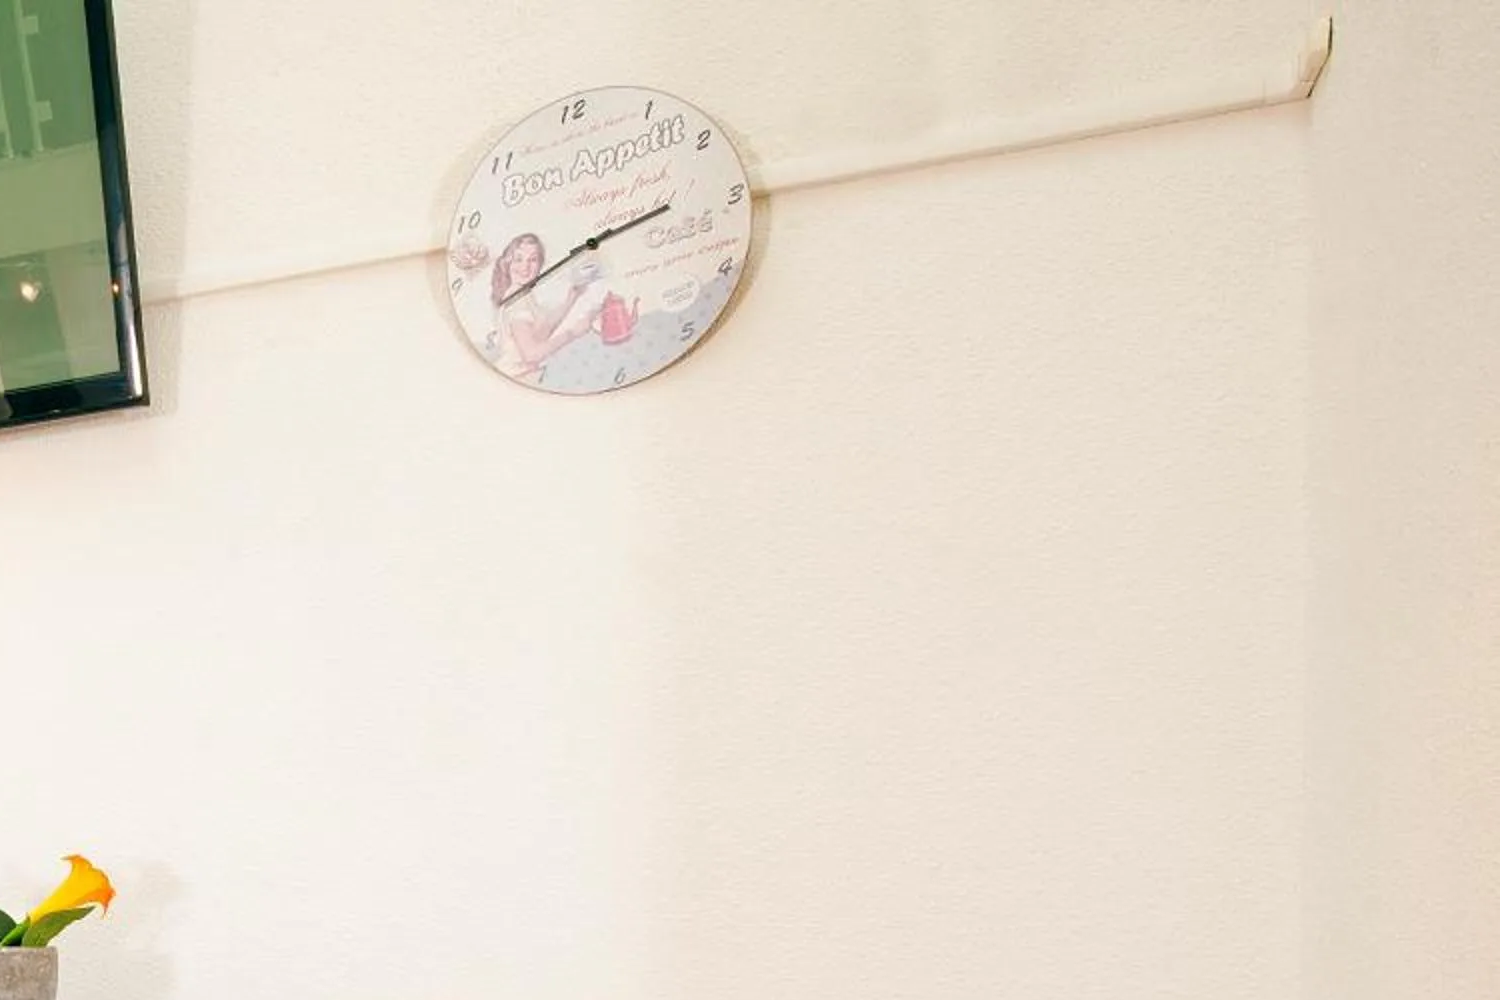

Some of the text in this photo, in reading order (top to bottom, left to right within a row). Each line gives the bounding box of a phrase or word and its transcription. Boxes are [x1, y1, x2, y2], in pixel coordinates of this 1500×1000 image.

[561, 98, 586, 125] 12
[644, 100, 655, 120] 1
[696, 129, 712, 151] 2
[491, 152, 513, 174] 11
[501, 168, 564, 207] Bon
[569, 113, 686, 182] Appetit
[727, 183, 744, 206] 3
[458, 210, 482, 233] 10
[717, 256, 733, 277] 4
[680, 321, 696, 342] 5
